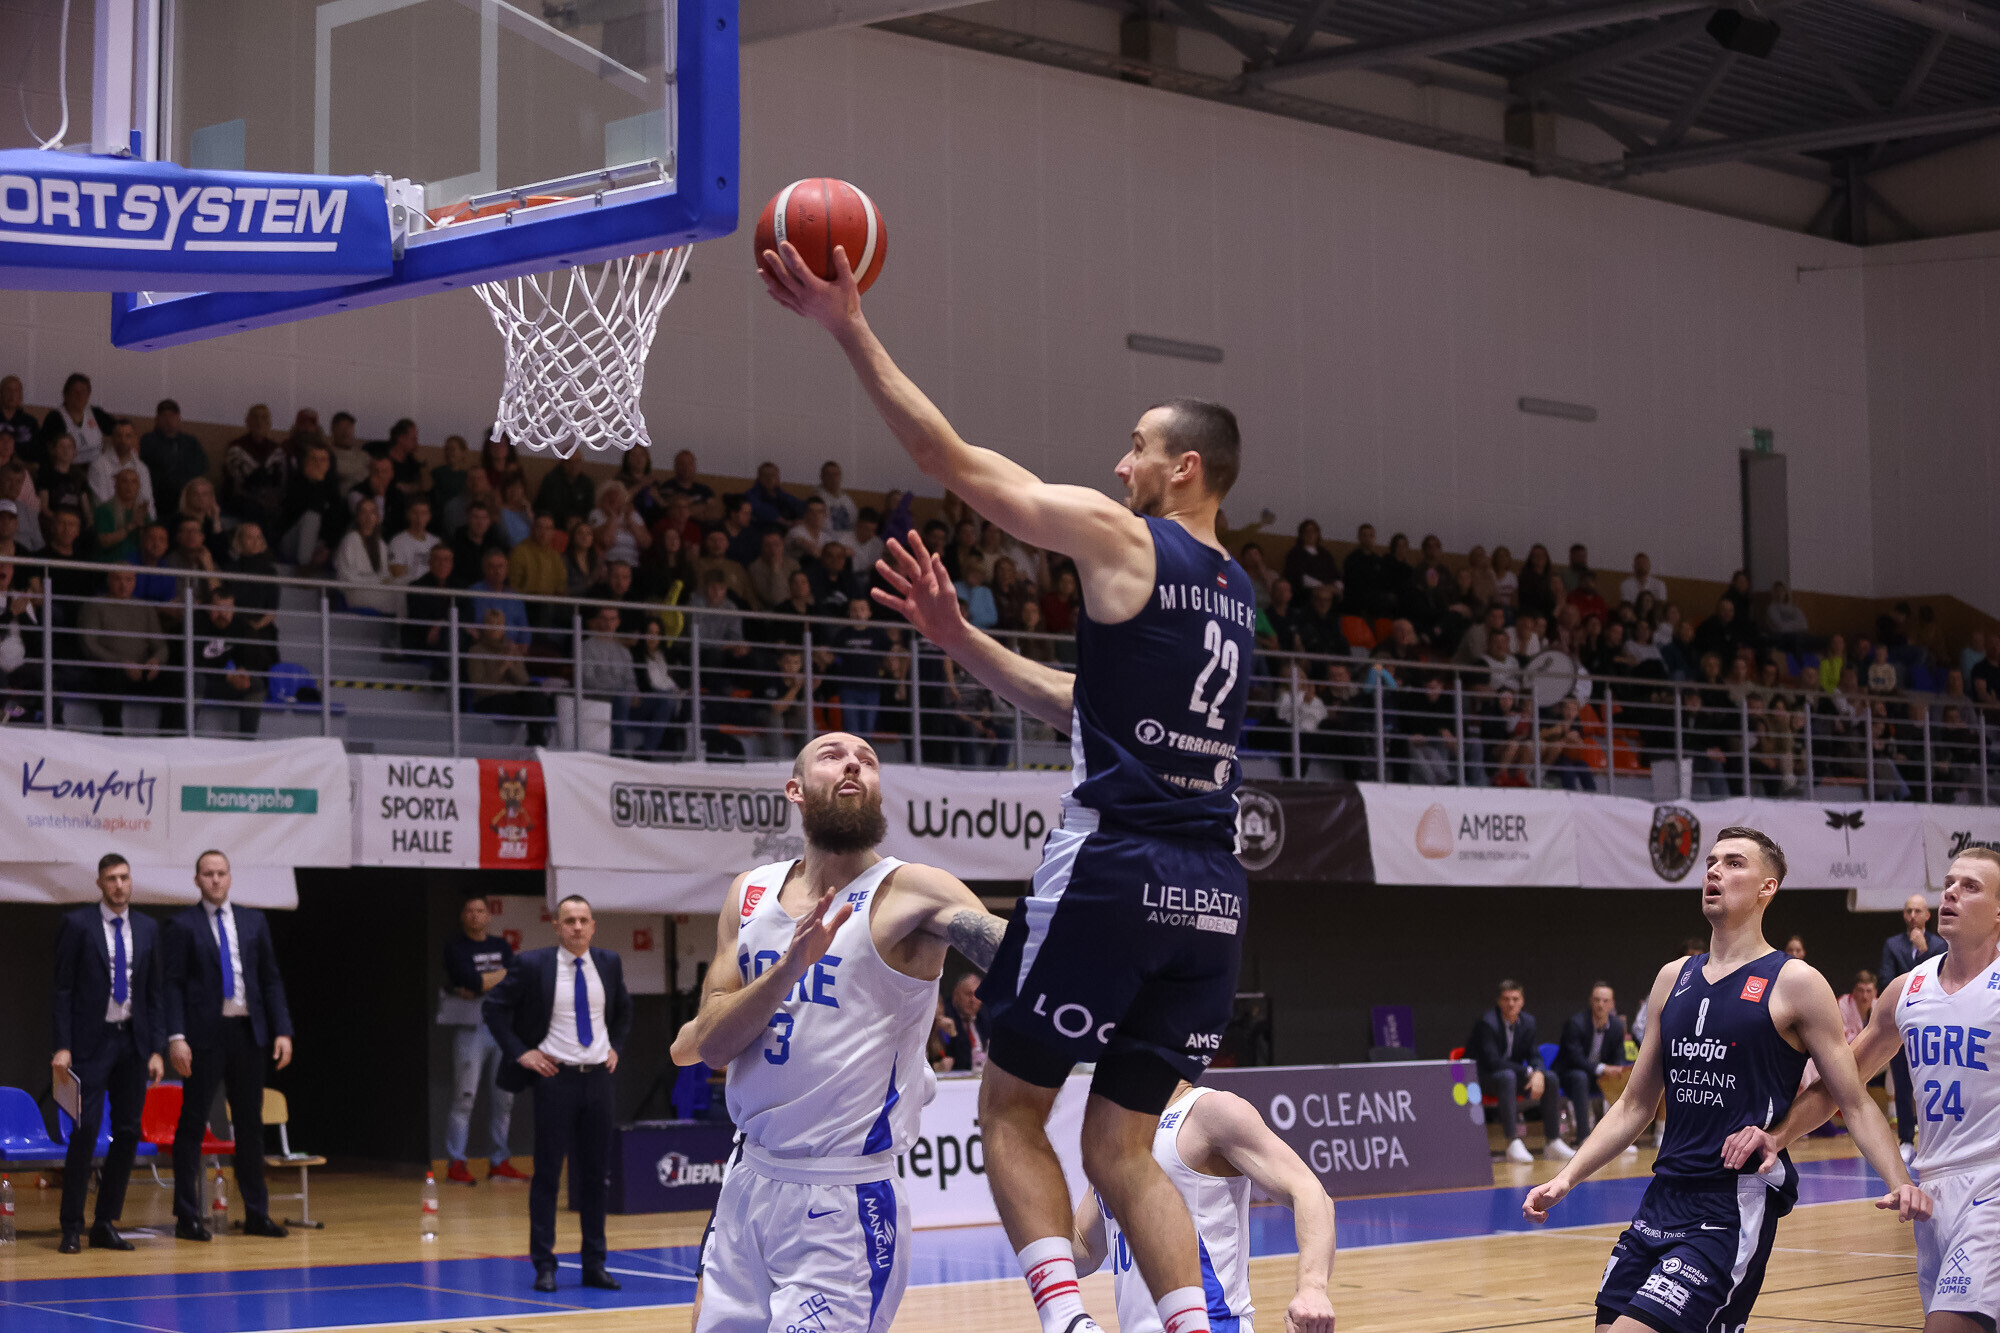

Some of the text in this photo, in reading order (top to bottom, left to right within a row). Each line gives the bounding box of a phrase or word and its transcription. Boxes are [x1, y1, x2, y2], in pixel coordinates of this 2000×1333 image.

[1189, 620, 1239, 731] 22
[206, 786, 294, 811] hansgrohe
[381, 796, 459, 821] SPORTA
[614, 787, 789, 829] STREETFOOD
[908, 797, 1045, 850] WindUp
[1458, 813, 1529, 842] AMBER
[392, 829, 453, 853] HALLE
[1147, 910, 1196, 927] AVOTA
[1695, 997, 1710, 1037] 8
[764, 1012, 795, 1066] 3
[1671, 1037, 1728, 1063] Liepāja
[1908, 1025, 1992, 1072] OGRE
[1676, 1069, 1736, 1090] CLEANR
[1302, 1089, 1417, 1128] CLEANR
[1676, 1088, 1724, 1108] GRUPA
[1923, 1079, 1965, 1122] 24
[1309, 1136, 1410, 1174] GRUPA
[1937, 1285, 1968, 1296] JUMIS
[1939, 1276, 1972, 1287] OGRES
